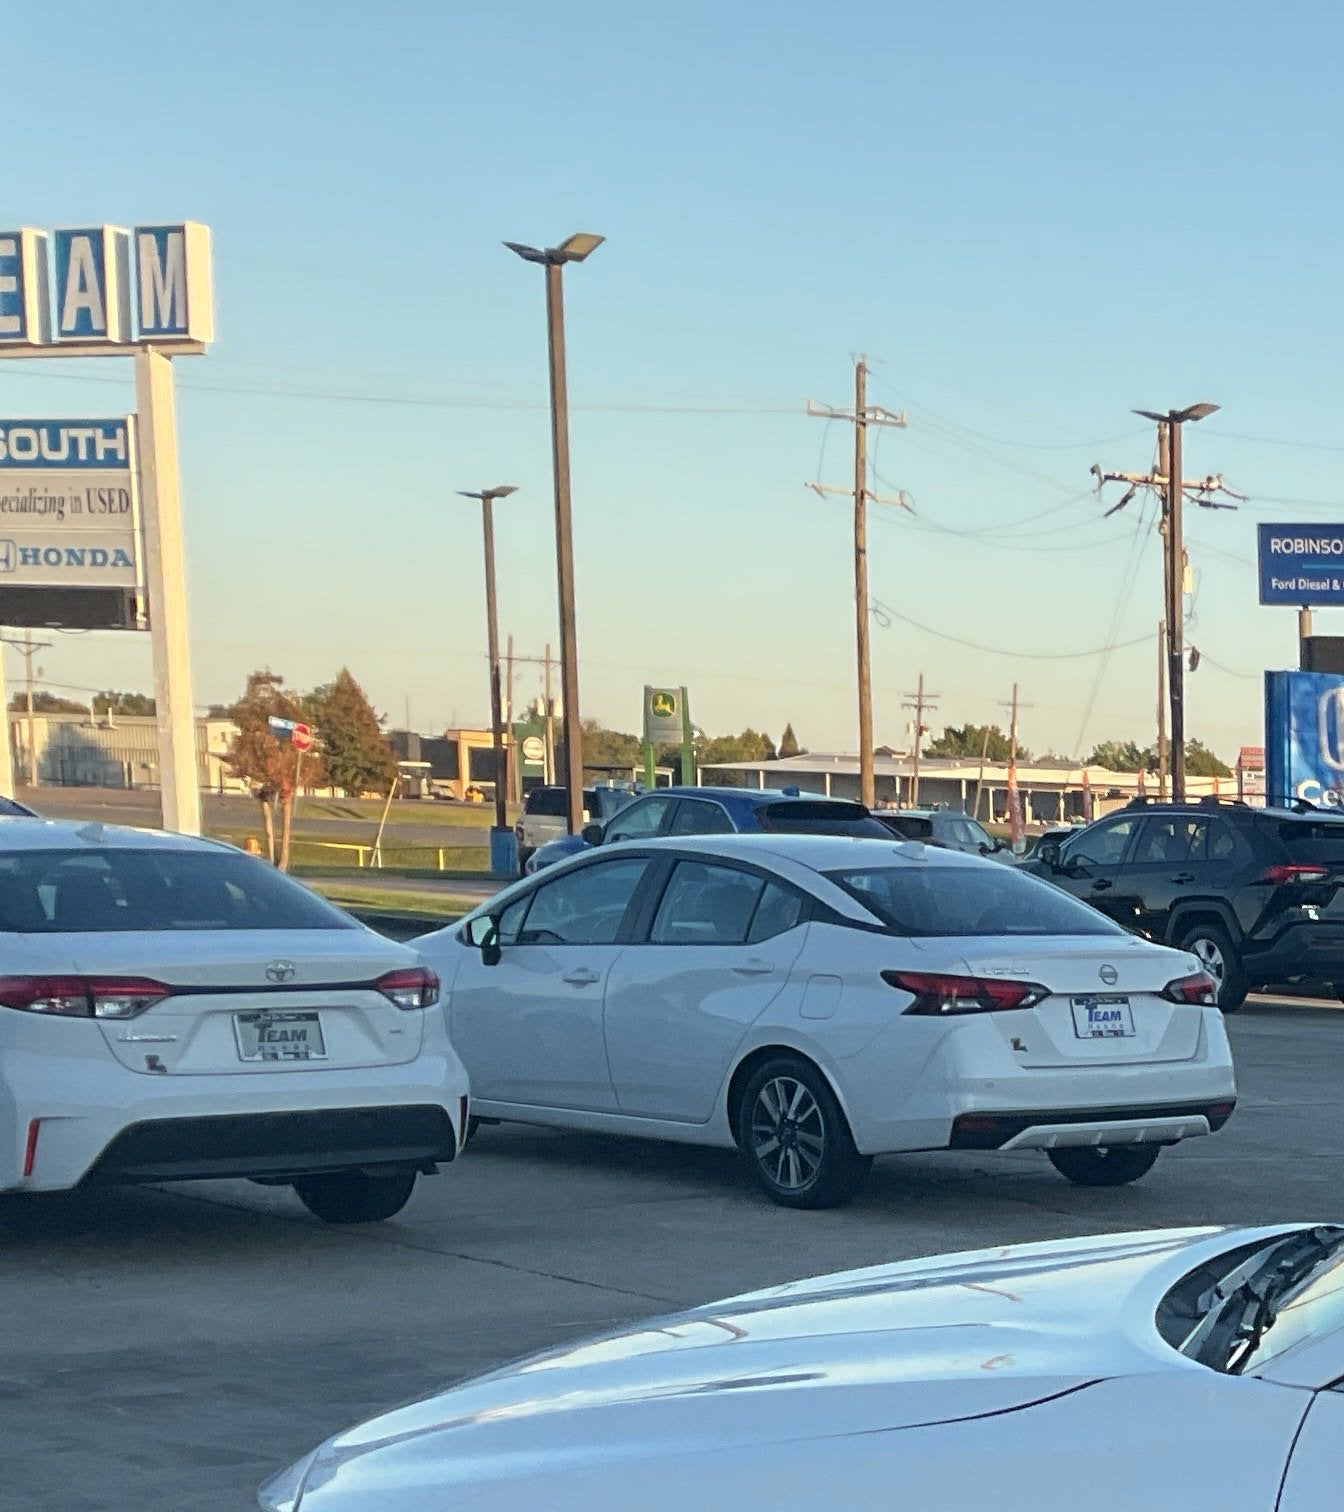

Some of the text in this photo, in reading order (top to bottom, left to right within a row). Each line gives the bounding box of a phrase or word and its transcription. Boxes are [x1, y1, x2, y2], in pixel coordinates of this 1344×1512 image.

[0, 428, 126, 461] OUTH
[70, 487, 83, 514] in
[87, 488, 130, 514] USED
[19, 547, 133, 568] HONDA
[1271, 578, 1296, 591] Ford
[1298, 578, 1330, 591] Diesel
[1333, 579, 1340, 591] &
[255, 1022, 307, 1043] TEAM
